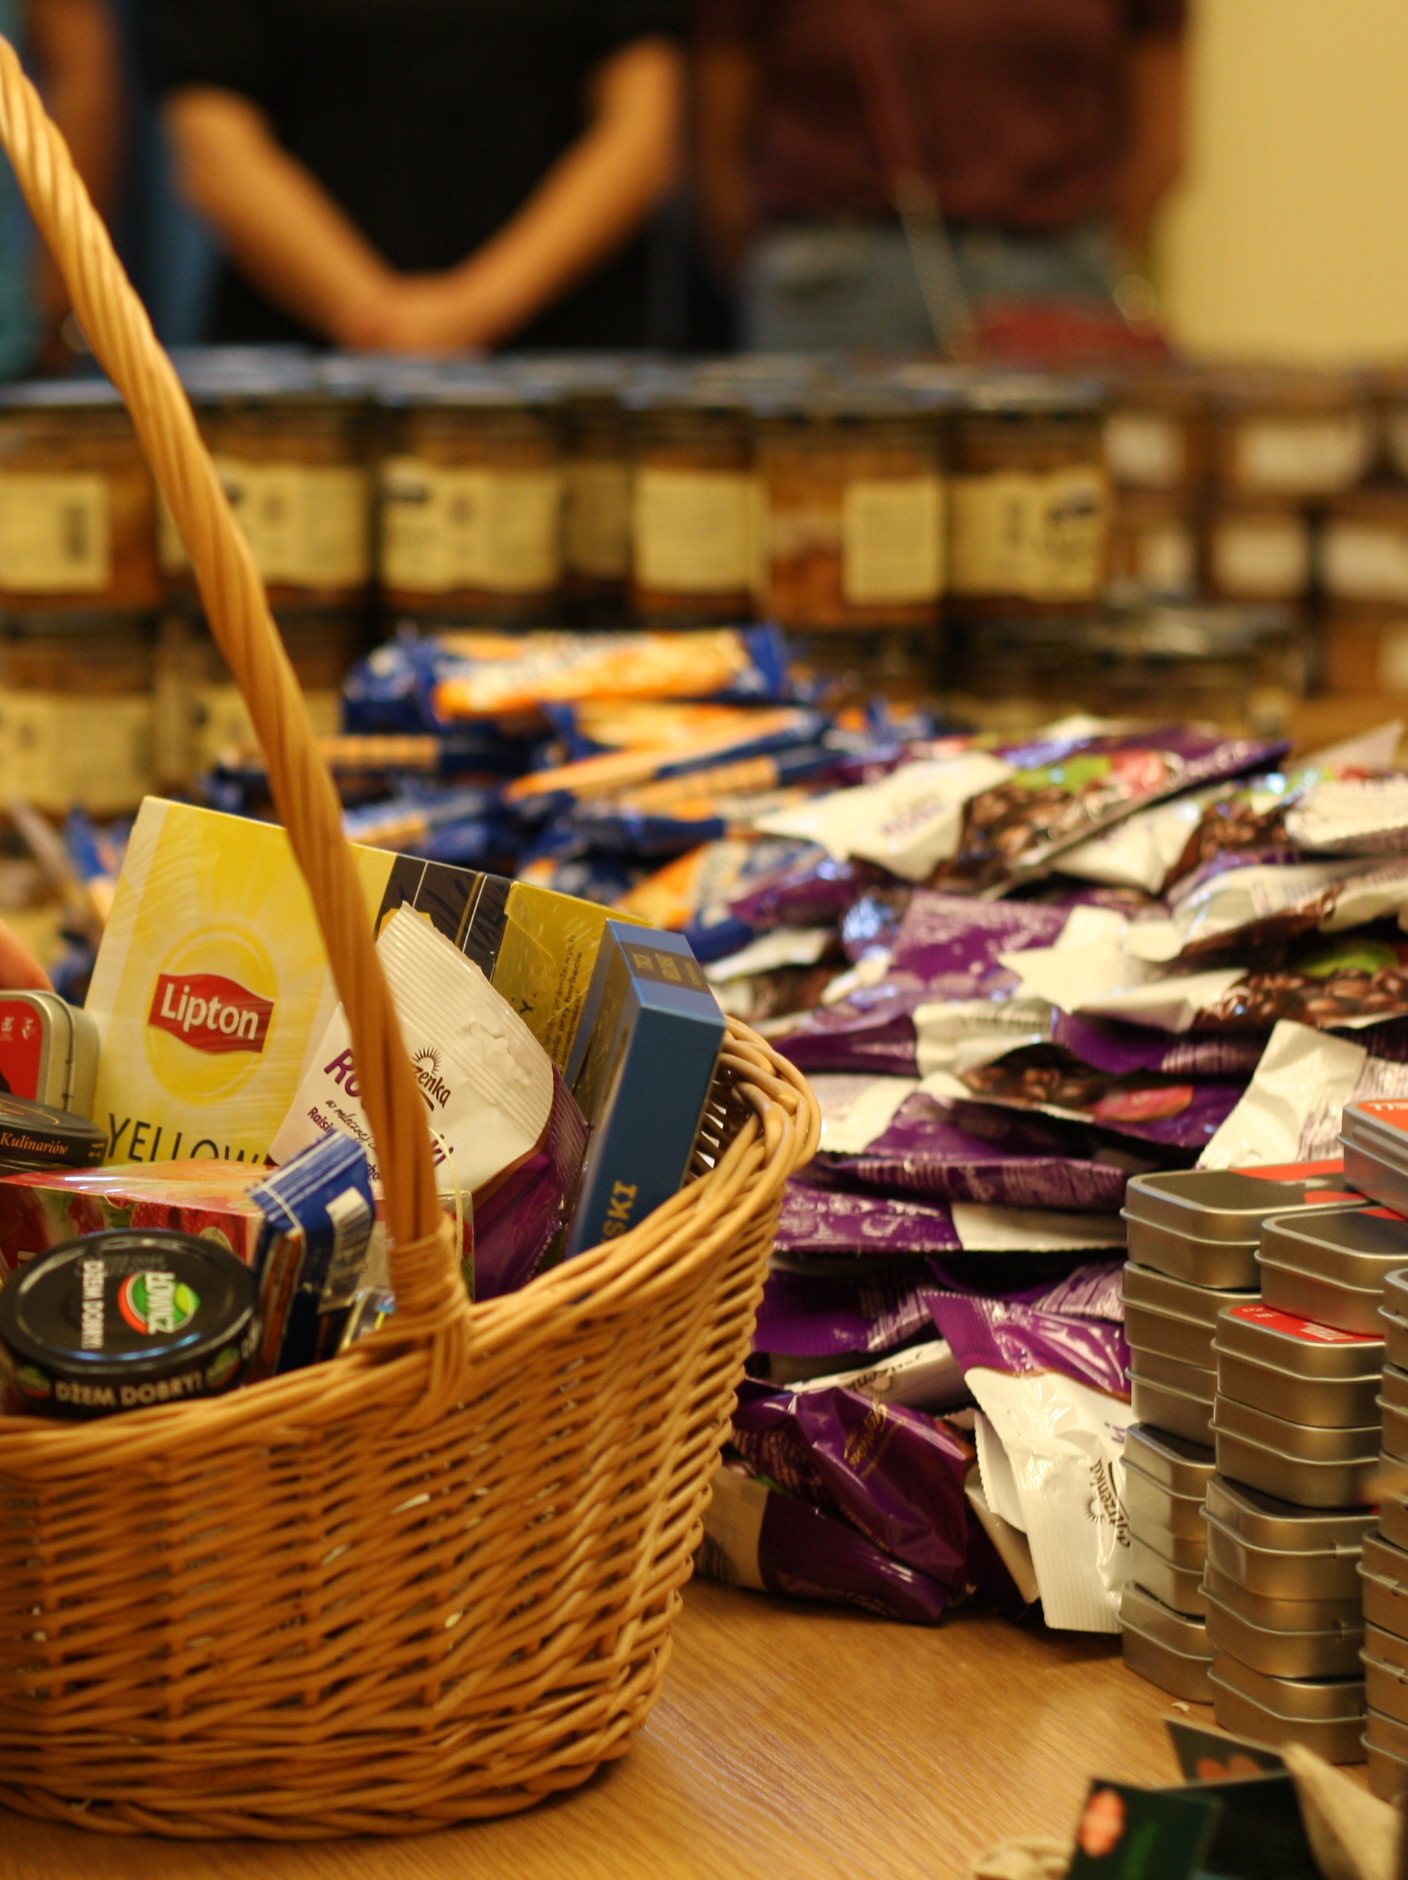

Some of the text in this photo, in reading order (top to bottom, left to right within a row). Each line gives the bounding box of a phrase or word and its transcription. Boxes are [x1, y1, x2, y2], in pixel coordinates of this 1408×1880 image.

[160, 983, 259, 1041] Lipton
[0, 1131, 69, 1156] Kulinariów
[81, 1260, 107, 1349] DŻEM DOBRY!
[145, 1272, 176, 1335] ŁOWICZ
[55, 1379, 116, 1407] DŻEM
[121, 1371, 204, 1405] DOBRY!
